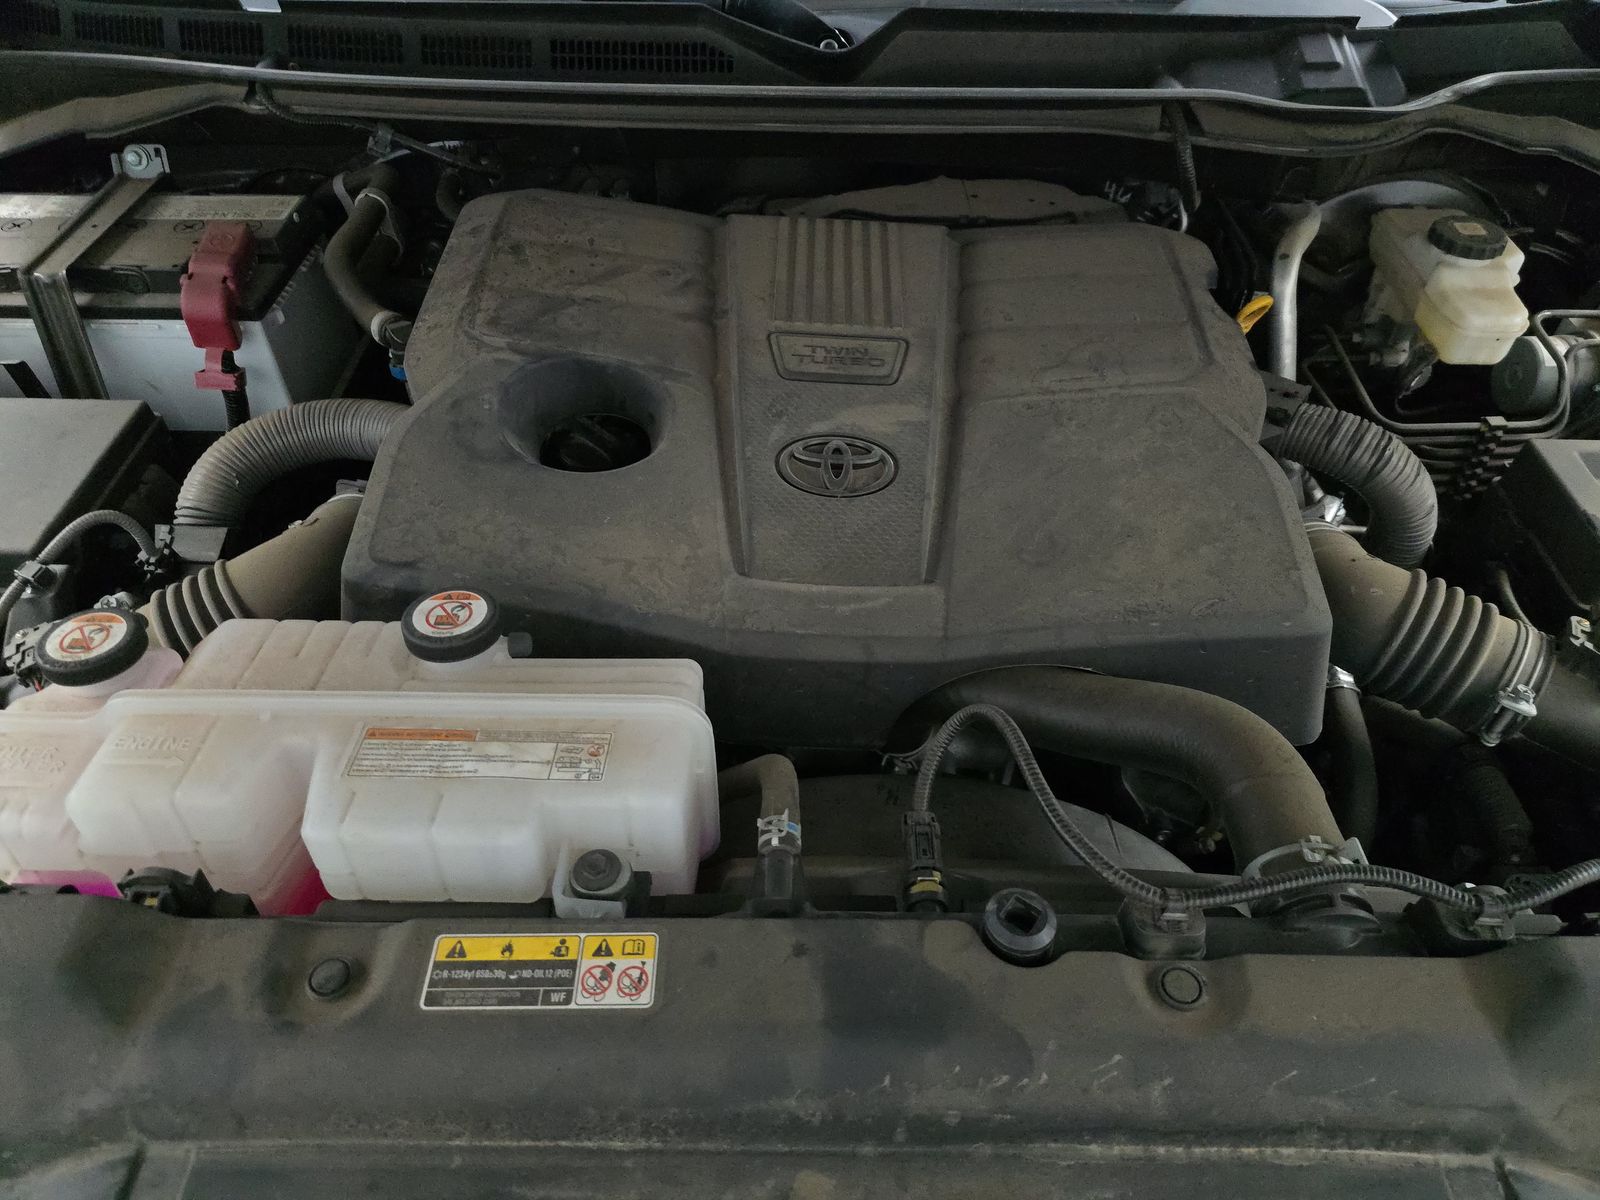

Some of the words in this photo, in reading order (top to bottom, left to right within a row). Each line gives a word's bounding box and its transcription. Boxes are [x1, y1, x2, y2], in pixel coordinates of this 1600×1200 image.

[803, 344, 869, 357] TWIN
[791, 353, 886, 368] TURBO
[114, 735, 192, 751] ENGINE
[550, 991, 567, 1003] WF
